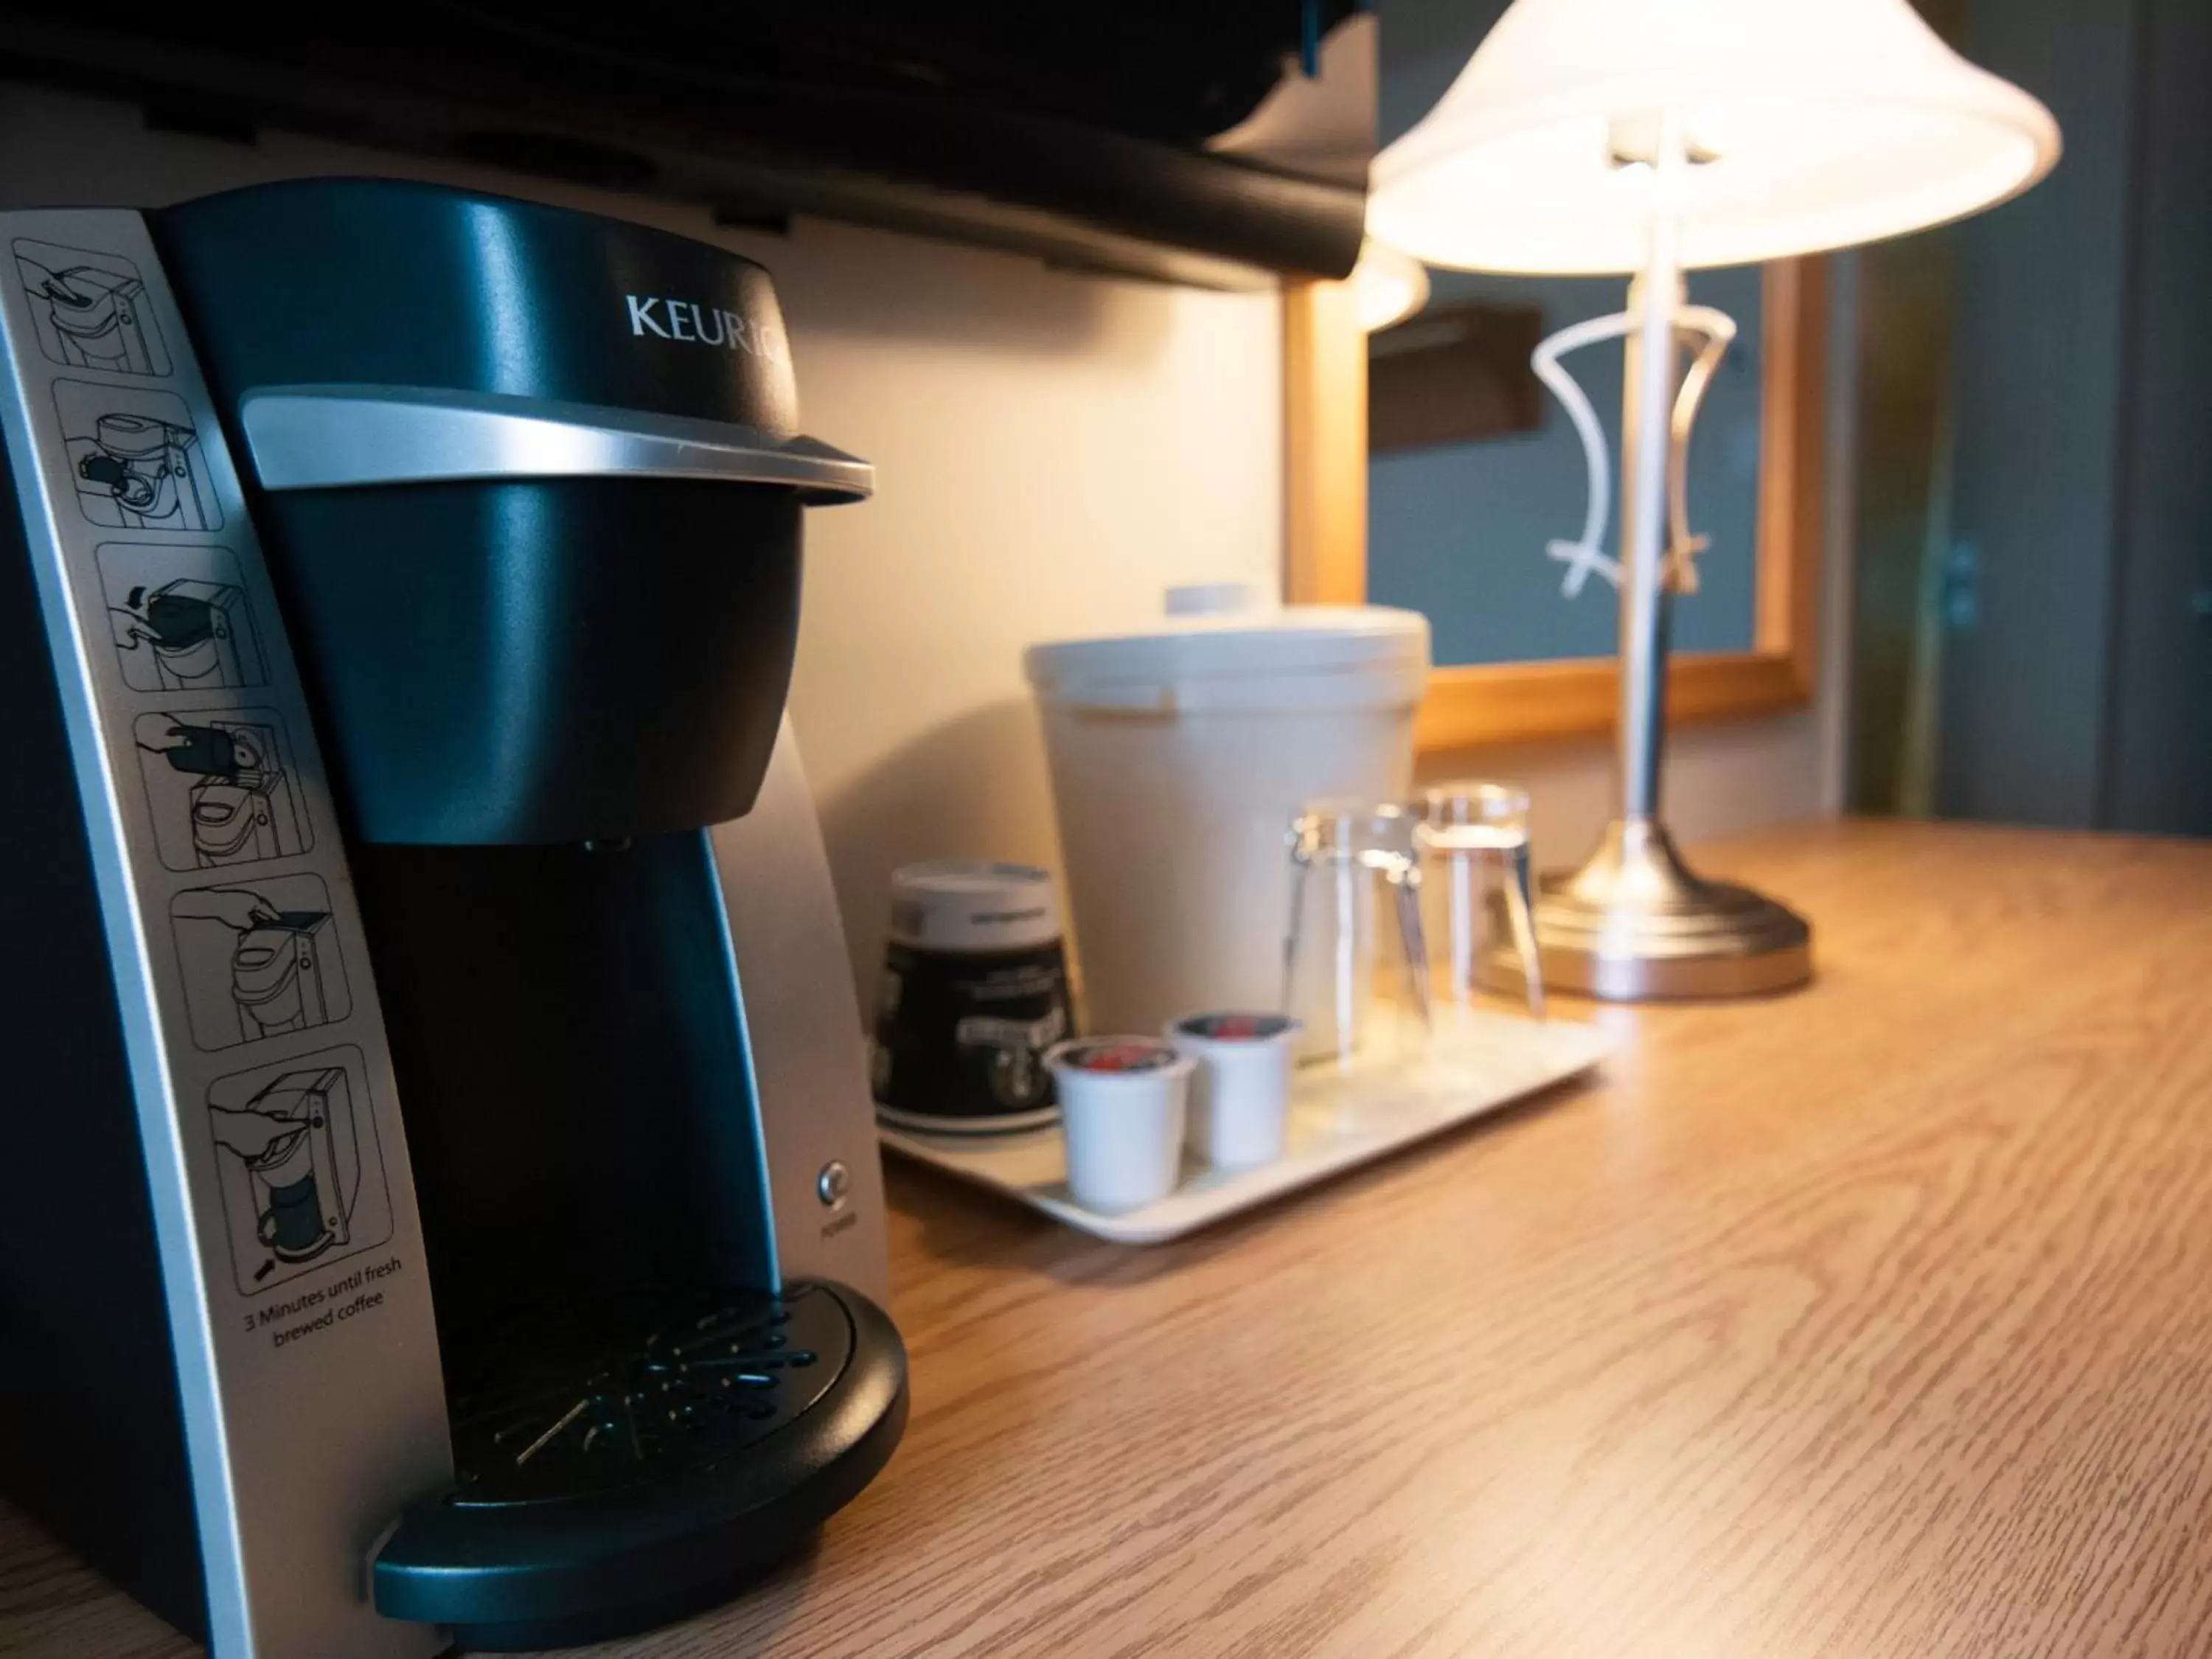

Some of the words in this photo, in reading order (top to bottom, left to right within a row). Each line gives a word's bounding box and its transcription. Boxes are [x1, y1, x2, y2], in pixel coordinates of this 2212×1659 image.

[243, 1315, 256, 1332] 3
[259, 1289, 326, 1326] Minutes
[328, 1273, 362, 1298] until
[364, 1256, 403, 1284] fresh
[273, 1310, 334, 1348] brewed
[337, 1290, 384, 1321] coffee
